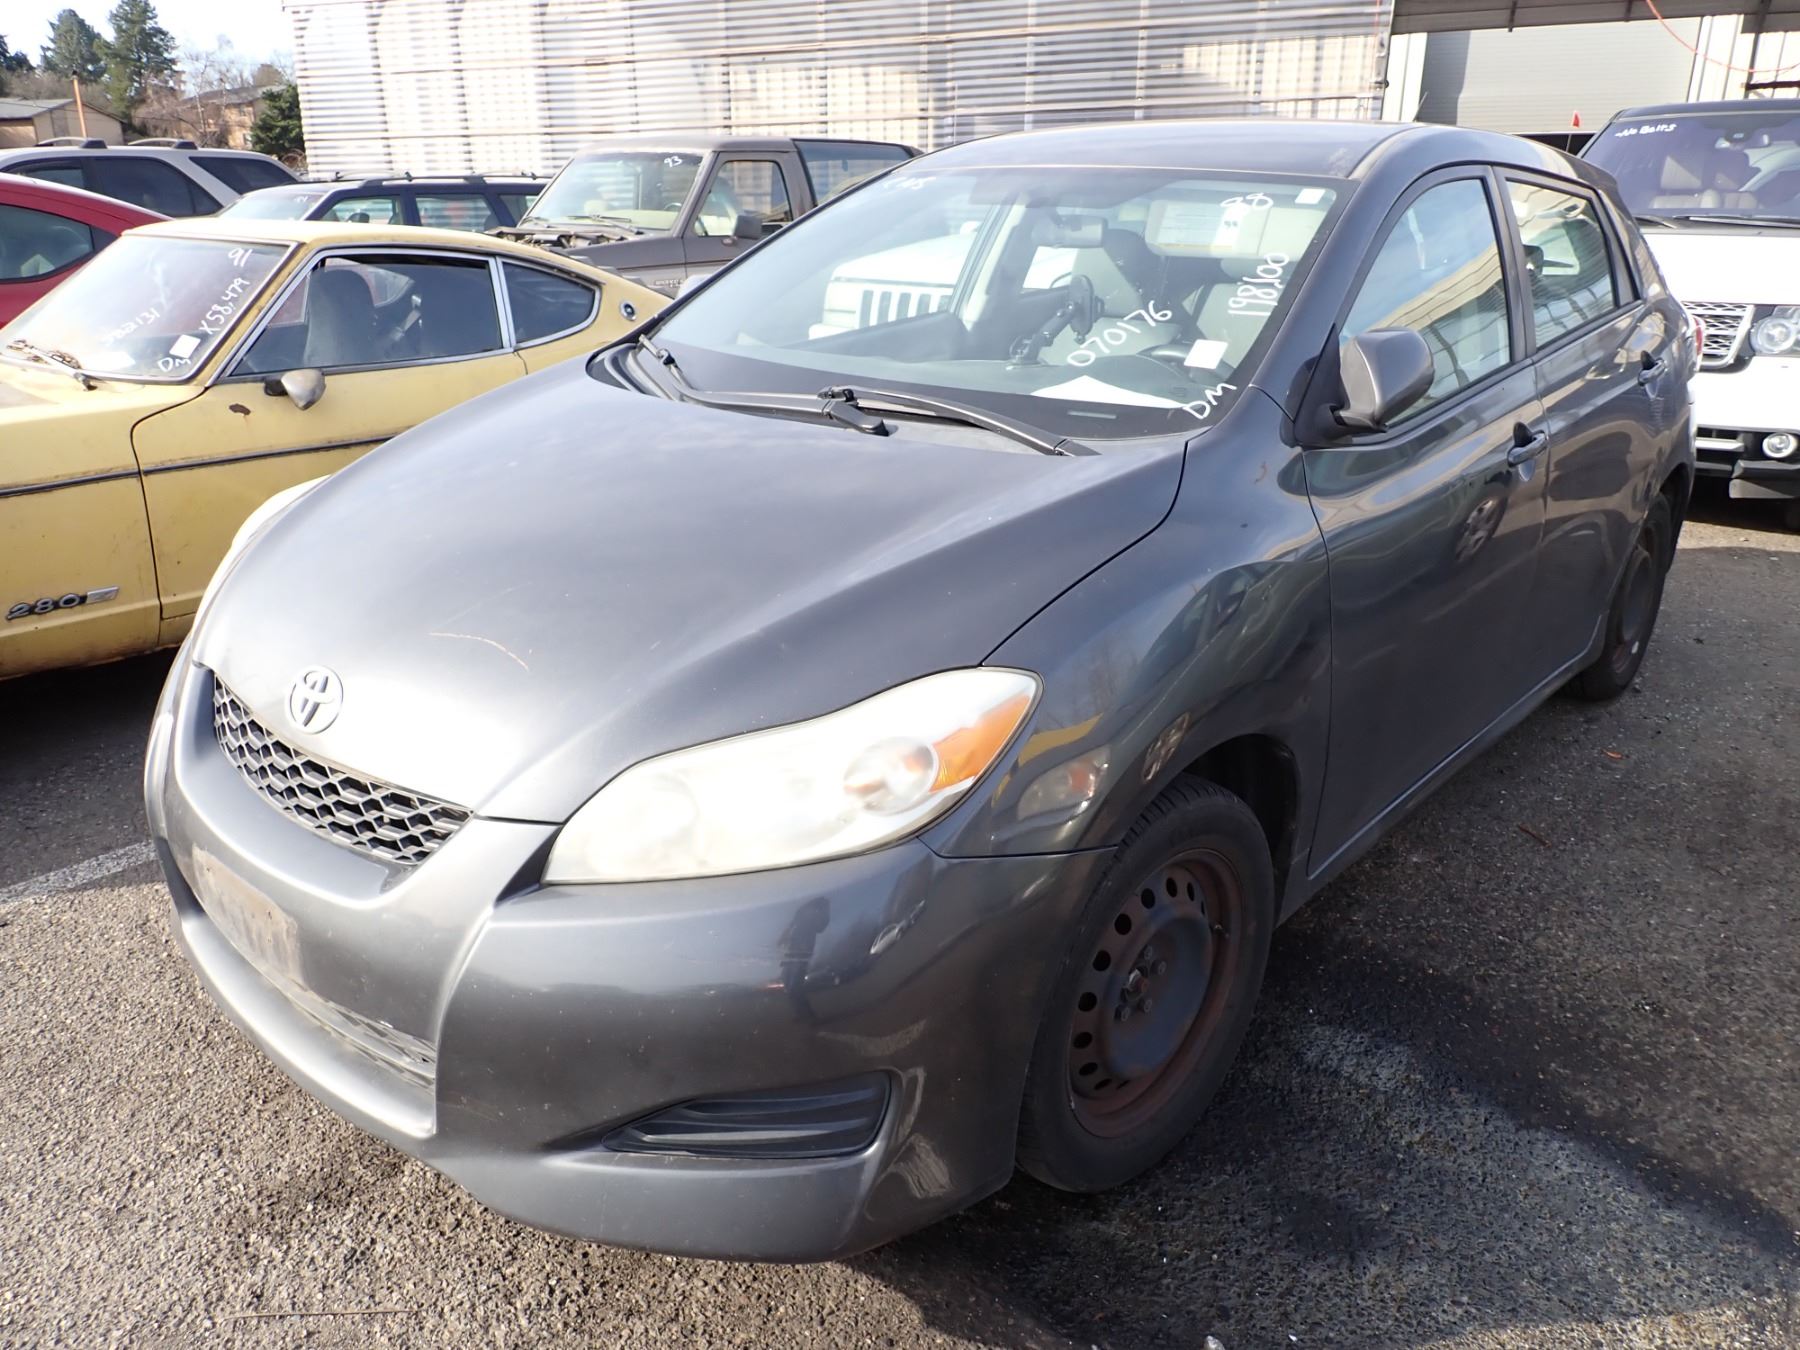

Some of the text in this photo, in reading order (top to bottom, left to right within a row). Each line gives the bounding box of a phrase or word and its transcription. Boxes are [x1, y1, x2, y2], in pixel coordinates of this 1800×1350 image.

[663, 155, 683, 168] 93
[1066, 299, 1173, 367] 070176
[157, 356, 192, 373] DM
[1182, 382, 1238, 420] DM
